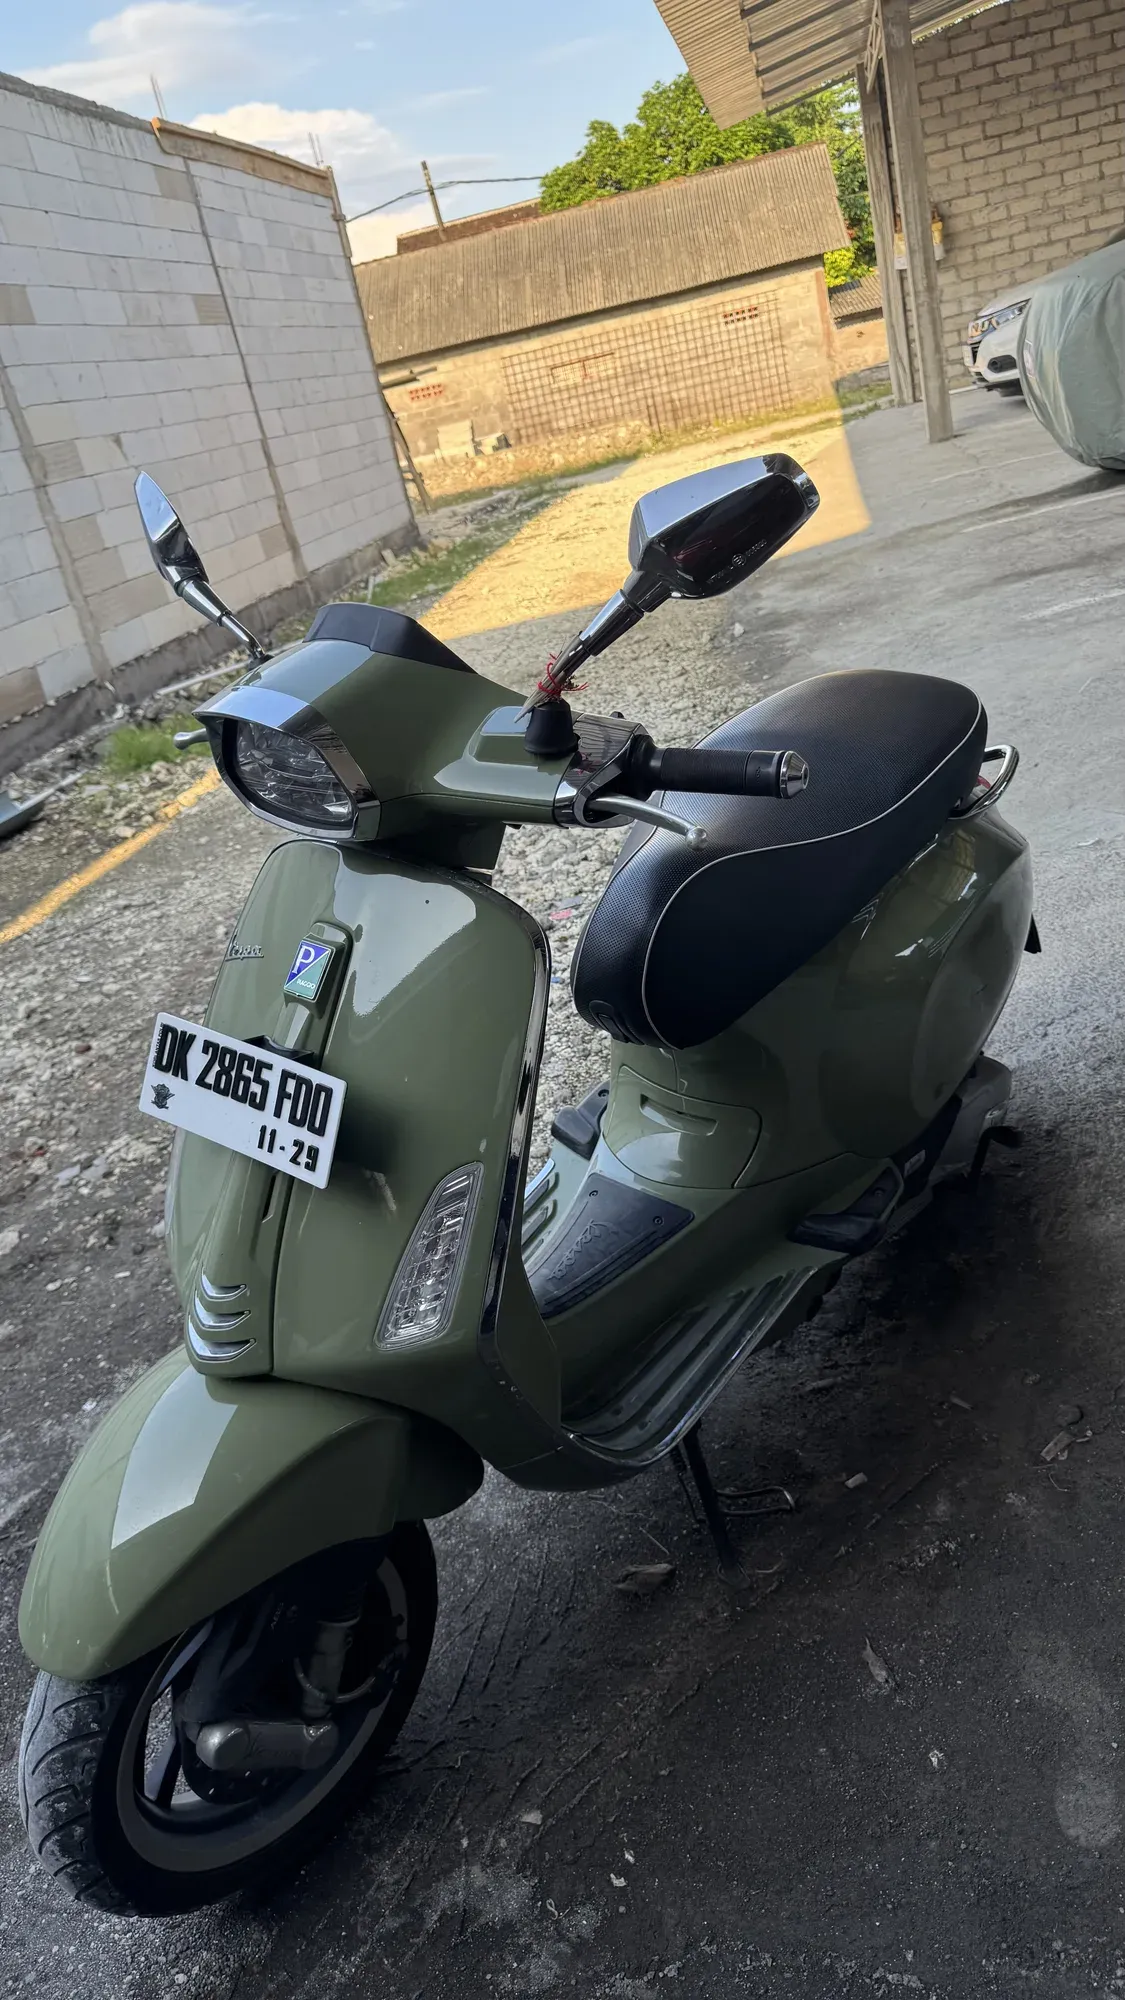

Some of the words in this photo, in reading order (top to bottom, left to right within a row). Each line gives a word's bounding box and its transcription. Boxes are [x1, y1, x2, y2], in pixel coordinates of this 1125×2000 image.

[154, 1023, 197, 1081] DK
[195, 1039, 273, 1112] 2865
[273, 1068, 333, 1137] FDO
